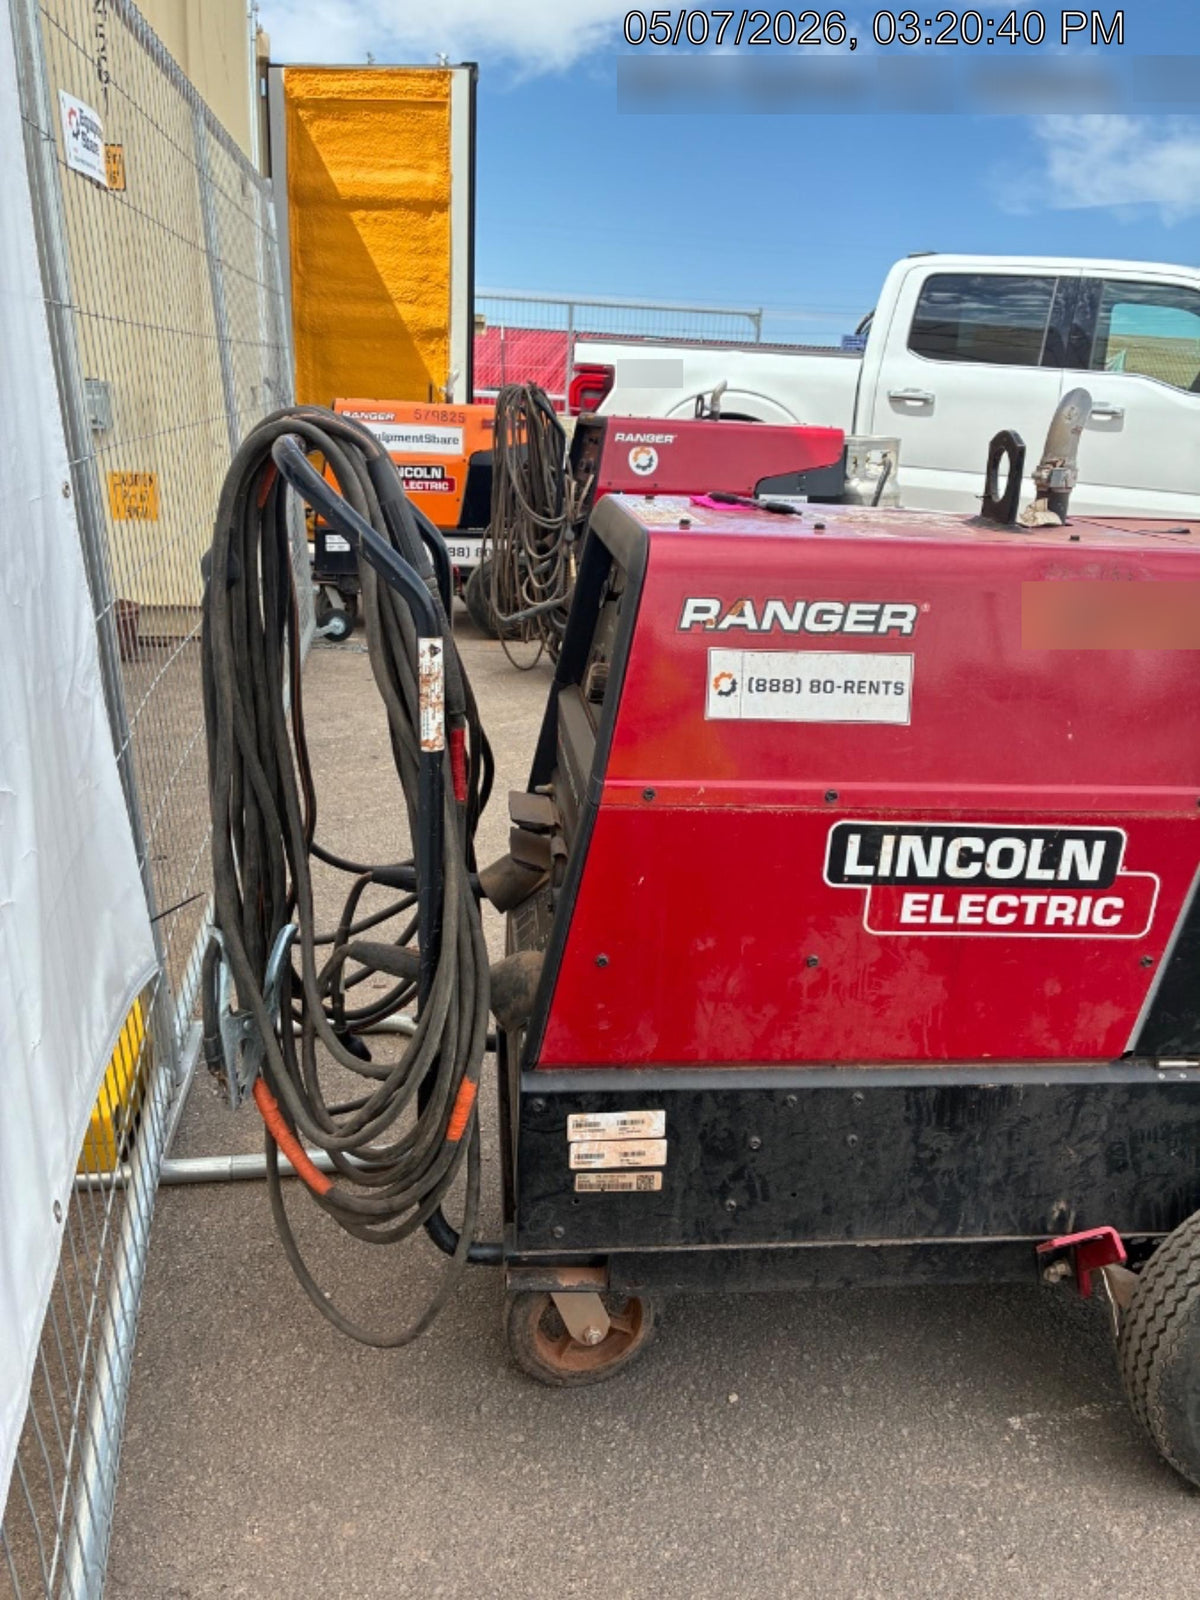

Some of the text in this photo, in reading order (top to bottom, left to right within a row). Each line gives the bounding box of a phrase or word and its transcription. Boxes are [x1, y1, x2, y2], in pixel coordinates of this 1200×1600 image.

[373, 431, 460, 446] uipmentShare
[614, 432, 675, 444] RANGER
[398, 466, 442, 479] NCOLN
[402, 480, 450, 491] LECTRIC
[679, 597, 919, 635] RANGER
[747, 676, 905, 697] (888) 80-RENTS
[843, 833, 1106, 882] LINCOLN
[900, 892, 1124, 927] ELECTRIC
